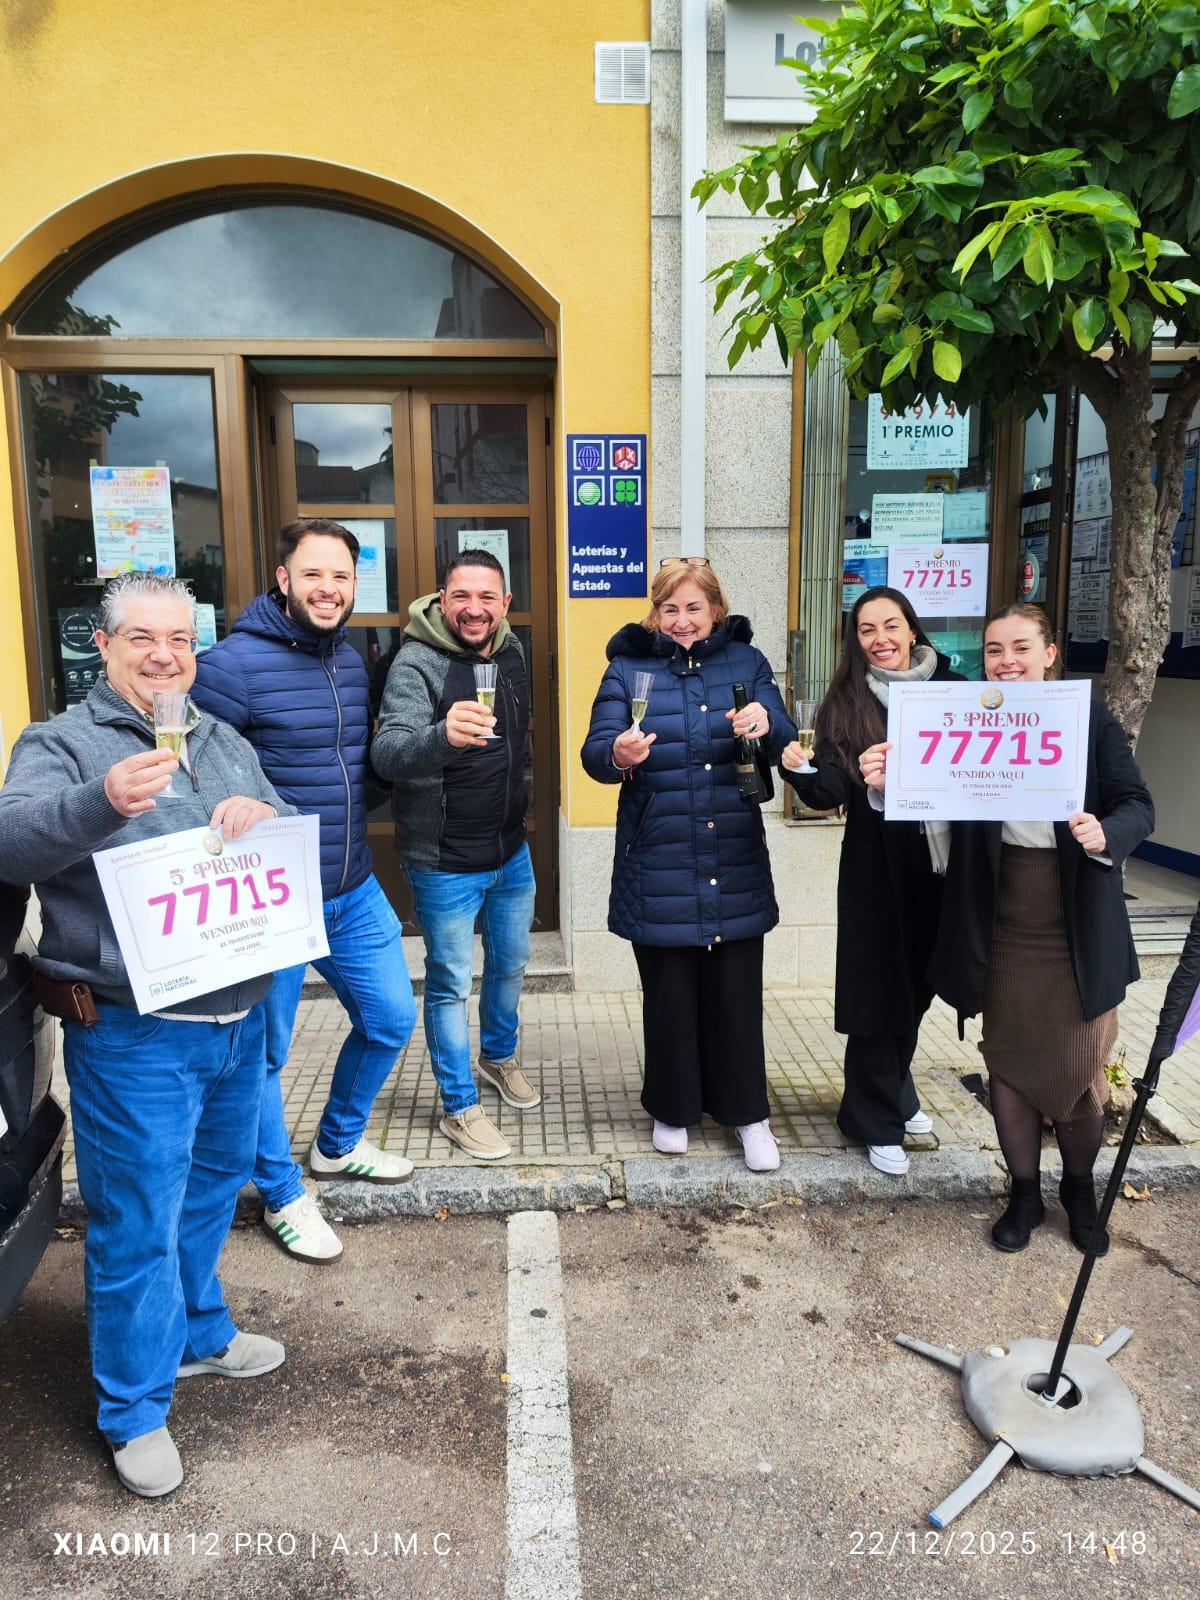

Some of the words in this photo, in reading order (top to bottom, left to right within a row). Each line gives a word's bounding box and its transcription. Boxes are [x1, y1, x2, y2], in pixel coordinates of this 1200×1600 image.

[895, 424, 954, 438] PREMIO
[572, 545, 617, 556] Loterías
[620, 547, 627, 558] y
[572, 562, 624, 576] Apuestas
[626, 562, 644, 573] del
[924, 559, 961, 568] PREMIO
[572, 579, 611, 591] Estado
[903, 569, 972, 588] 77715
[964, 712, 1040, 728] PREMIO
[918, 730, 1063, 766] 77715
[949, 770, 995, 779] VENDIDO
[193, 852, 262, 879] PREMIO
[147, 867, 290, 936] 77715
[200, 920, 249, 941] VENDIDO
[165, 979, 198, 992] NACIONAL
